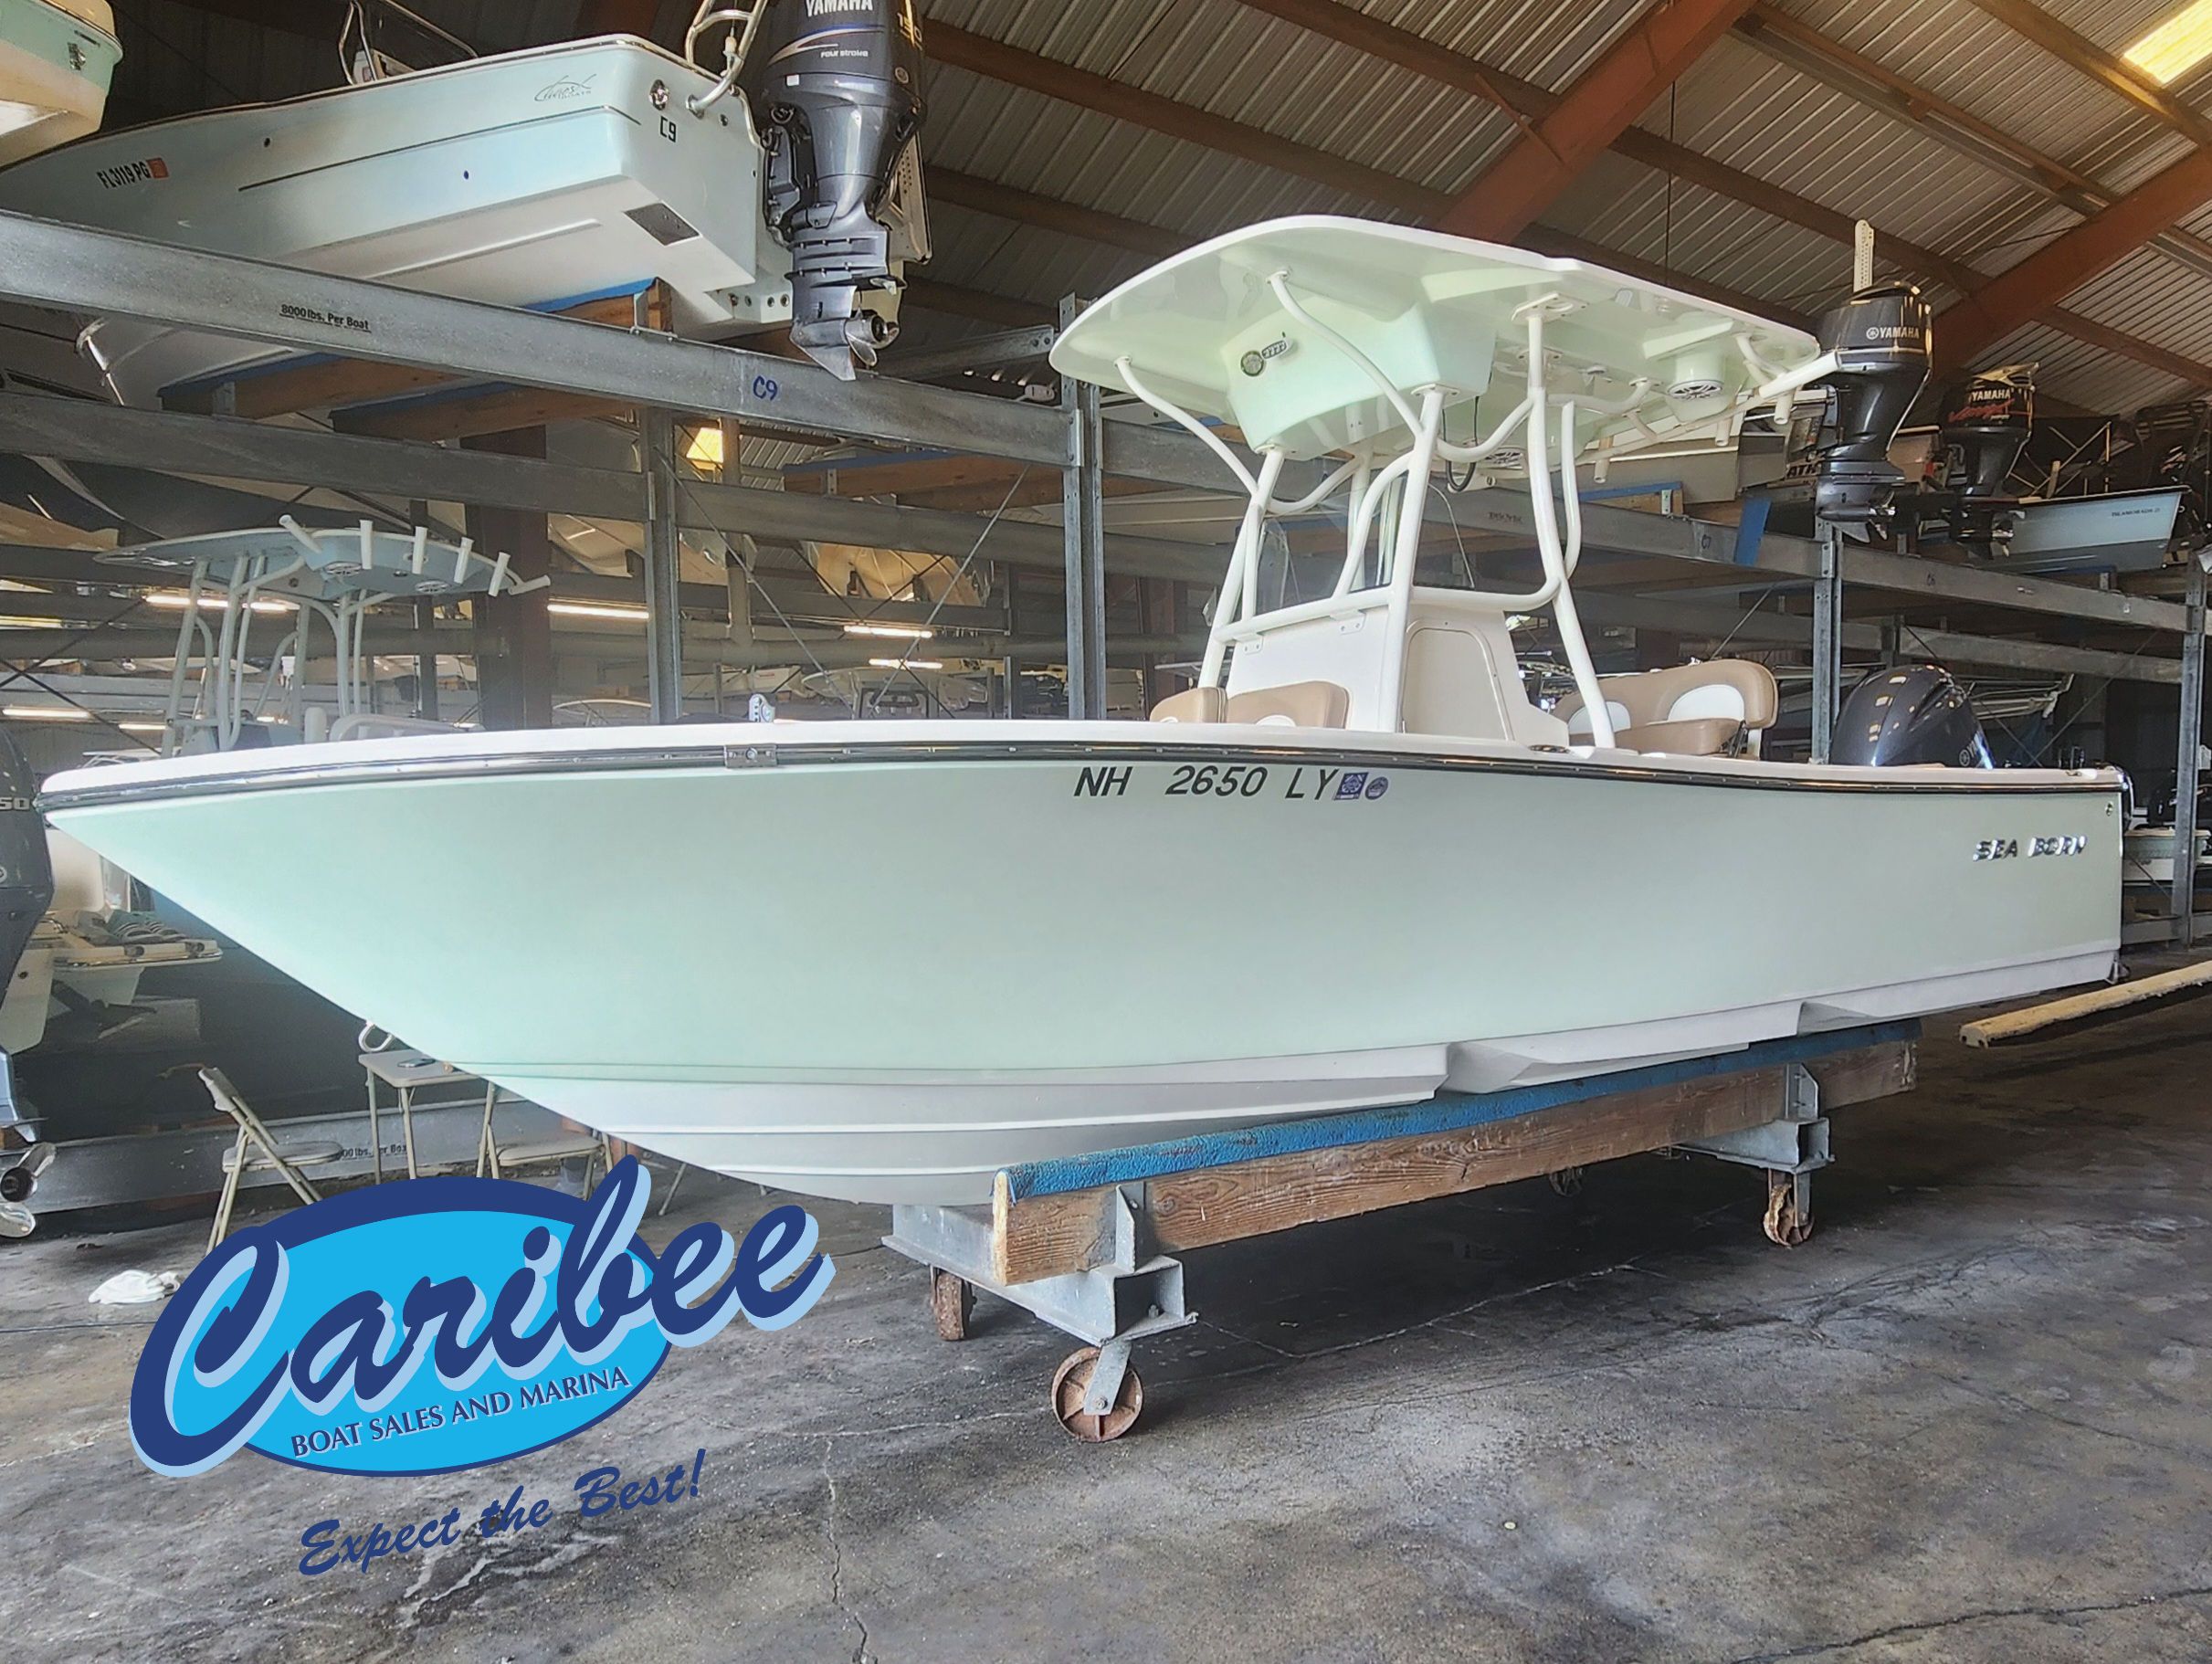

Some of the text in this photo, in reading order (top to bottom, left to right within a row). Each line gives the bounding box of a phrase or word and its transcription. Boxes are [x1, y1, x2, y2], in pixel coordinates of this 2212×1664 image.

[805, 0, 873, 17] YAMAHA
[660, 115, 677, 142] C9
[327, 312, 344, 325] Per
[346, 316, 369, 330] Boat
[1880, 326, 1920, 339] YAMAHA
[753, 375, 778, 401] C9
[1973, 389, 2011, 402] YAMAHA
[1073, 766, 1133, 797] NH
[1164, 764, 1269, 797] 2650
[1284, 767, 1340, 801] LY
[1973, 836, 2088, 861] SEA BORN
